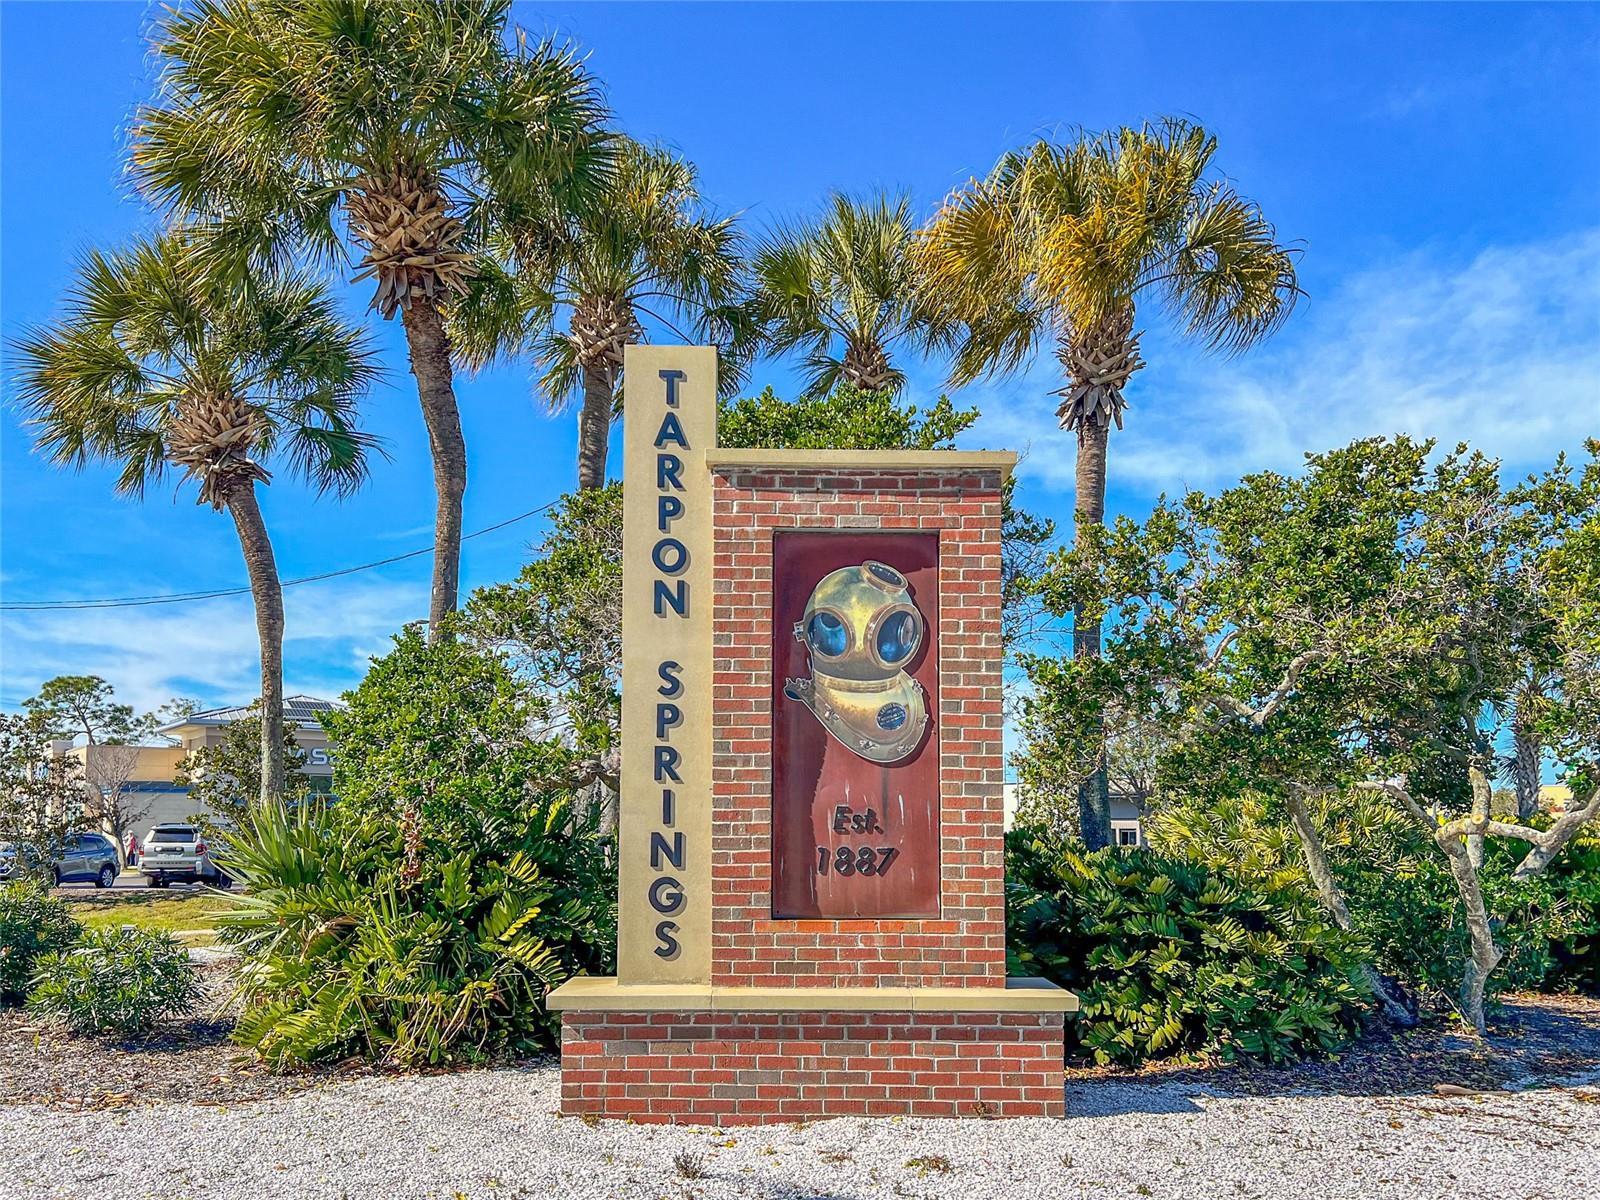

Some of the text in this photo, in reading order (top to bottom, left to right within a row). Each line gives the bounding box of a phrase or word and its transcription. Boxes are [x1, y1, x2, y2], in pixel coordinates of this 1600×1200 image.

[648, 369, 692, 961] TARPON SPRINGS
[833, 804, 884, 835] Est.
[817, 846, 900, 877] 1887
